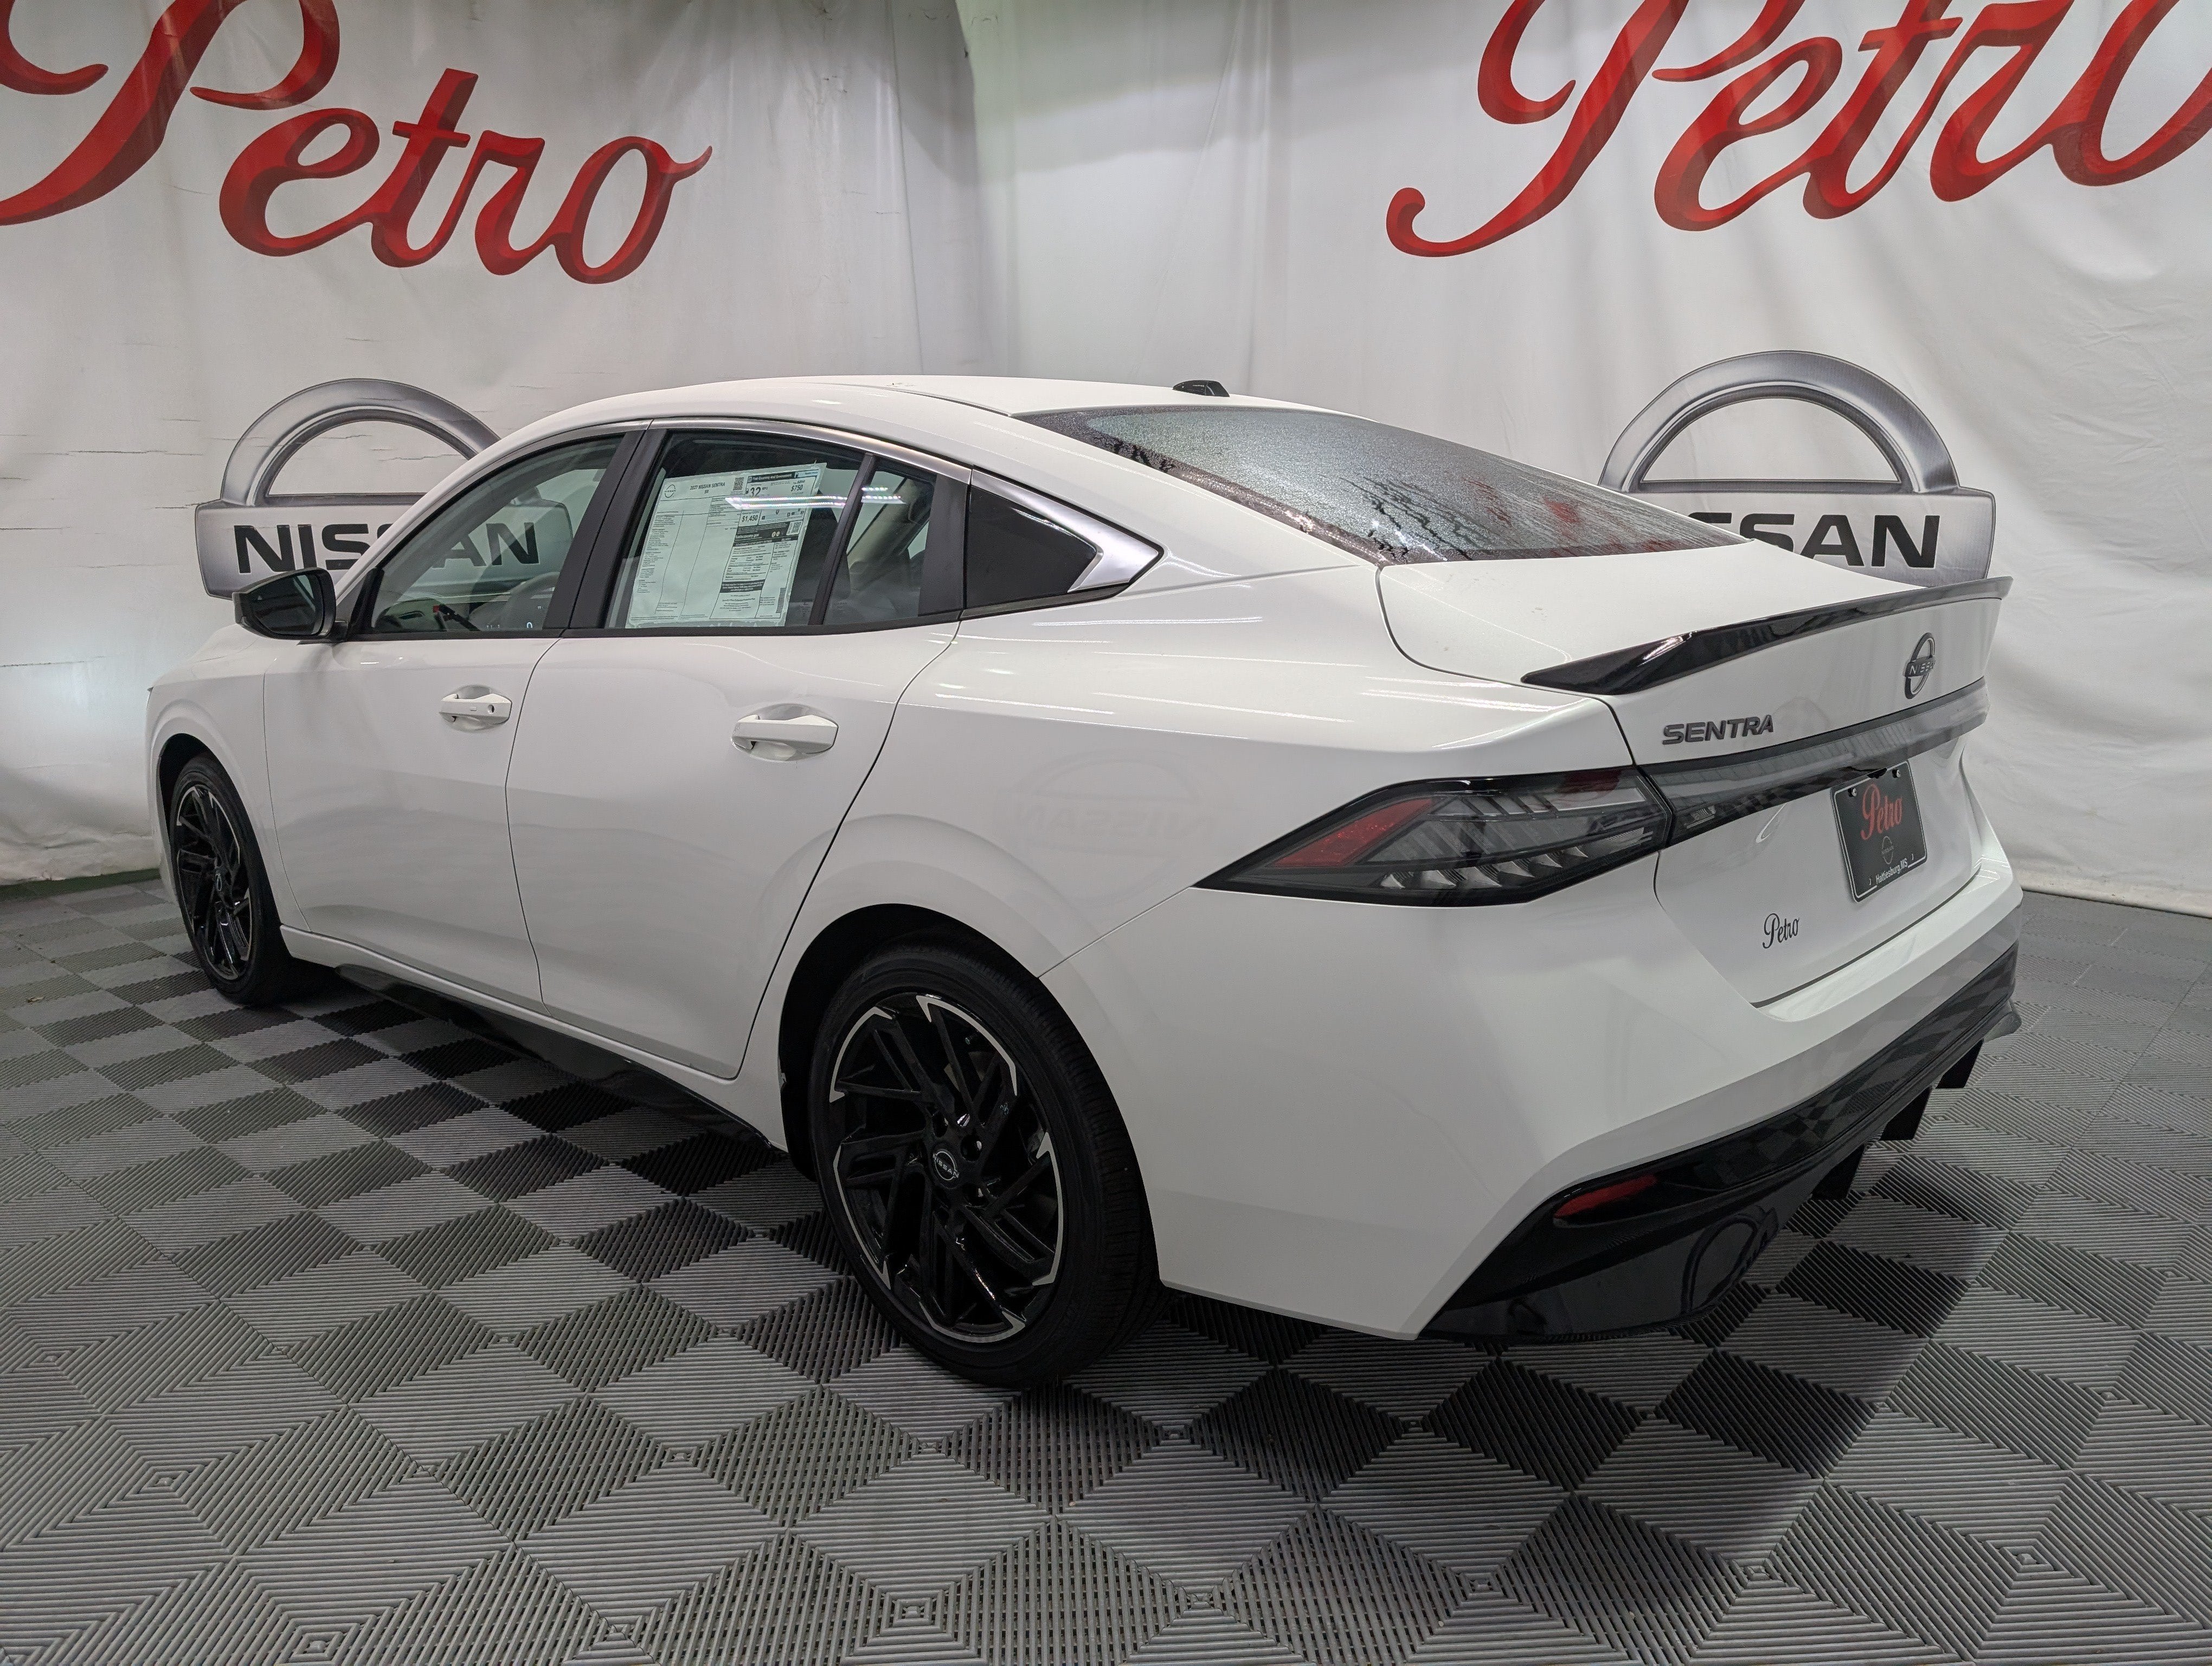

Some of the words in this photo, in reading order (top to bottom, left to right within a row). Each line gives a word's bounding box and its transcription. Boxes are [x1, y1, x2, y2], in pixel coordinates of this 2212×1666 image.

[0, 0, 712, 284] Petro
[1386, 0, 2212, 257] Petro
[742, 515, 758, 523] $1,450
[234, 522, 539, 573] NISAN
[1662, 714, 1774, 745] SENTRA
[1860, 784, 1902, 840] Petro
[1762, 913, 1800, 949] Petro
[933, 1153, 960, 1178] NISSAN
